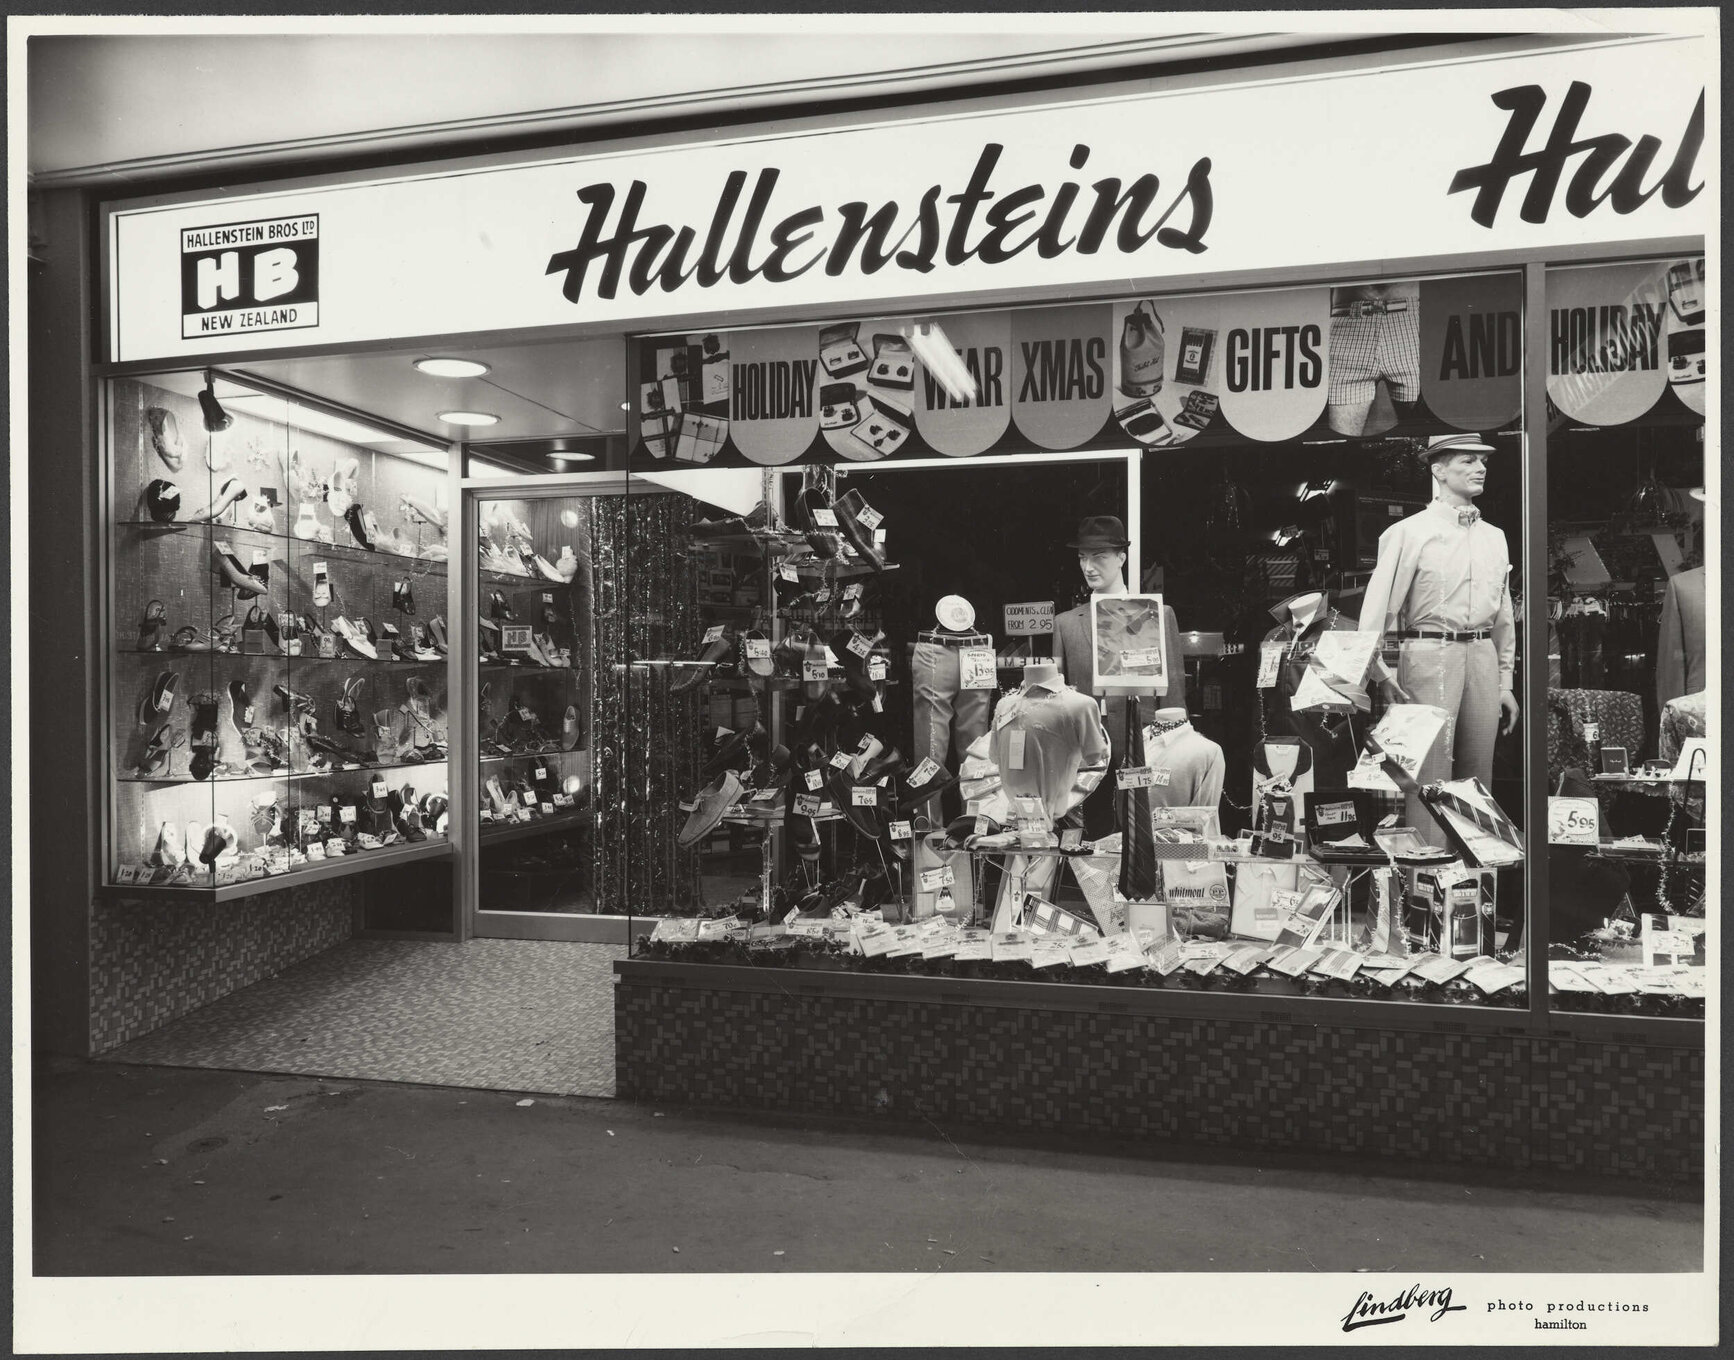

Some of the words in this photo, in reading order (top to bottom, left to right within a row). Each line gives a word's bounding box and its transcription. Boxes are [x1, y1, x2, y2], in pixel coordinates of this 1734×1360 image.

[187, 226, 264, 248] HALLENSTEIN
[269, 222, 298, 238] BROS
[302, 220, 315, 235] LTD
[545, 143, 1213, 304] Hallensteins
[201, 314, 233, 331] NEW
[240, 308, 298, 328] ZEALAND
[1551, 302, 1667, 375] HOLIDAY
[732, 359, 818, 422] HOLIDAY
[1018, 337, 1106, 403] XMAS
[1226, 324, 1322, 393] GIFTS
[1439, 311, 1521, 381] AND
[1008, 620, 1024, 630] FROM
